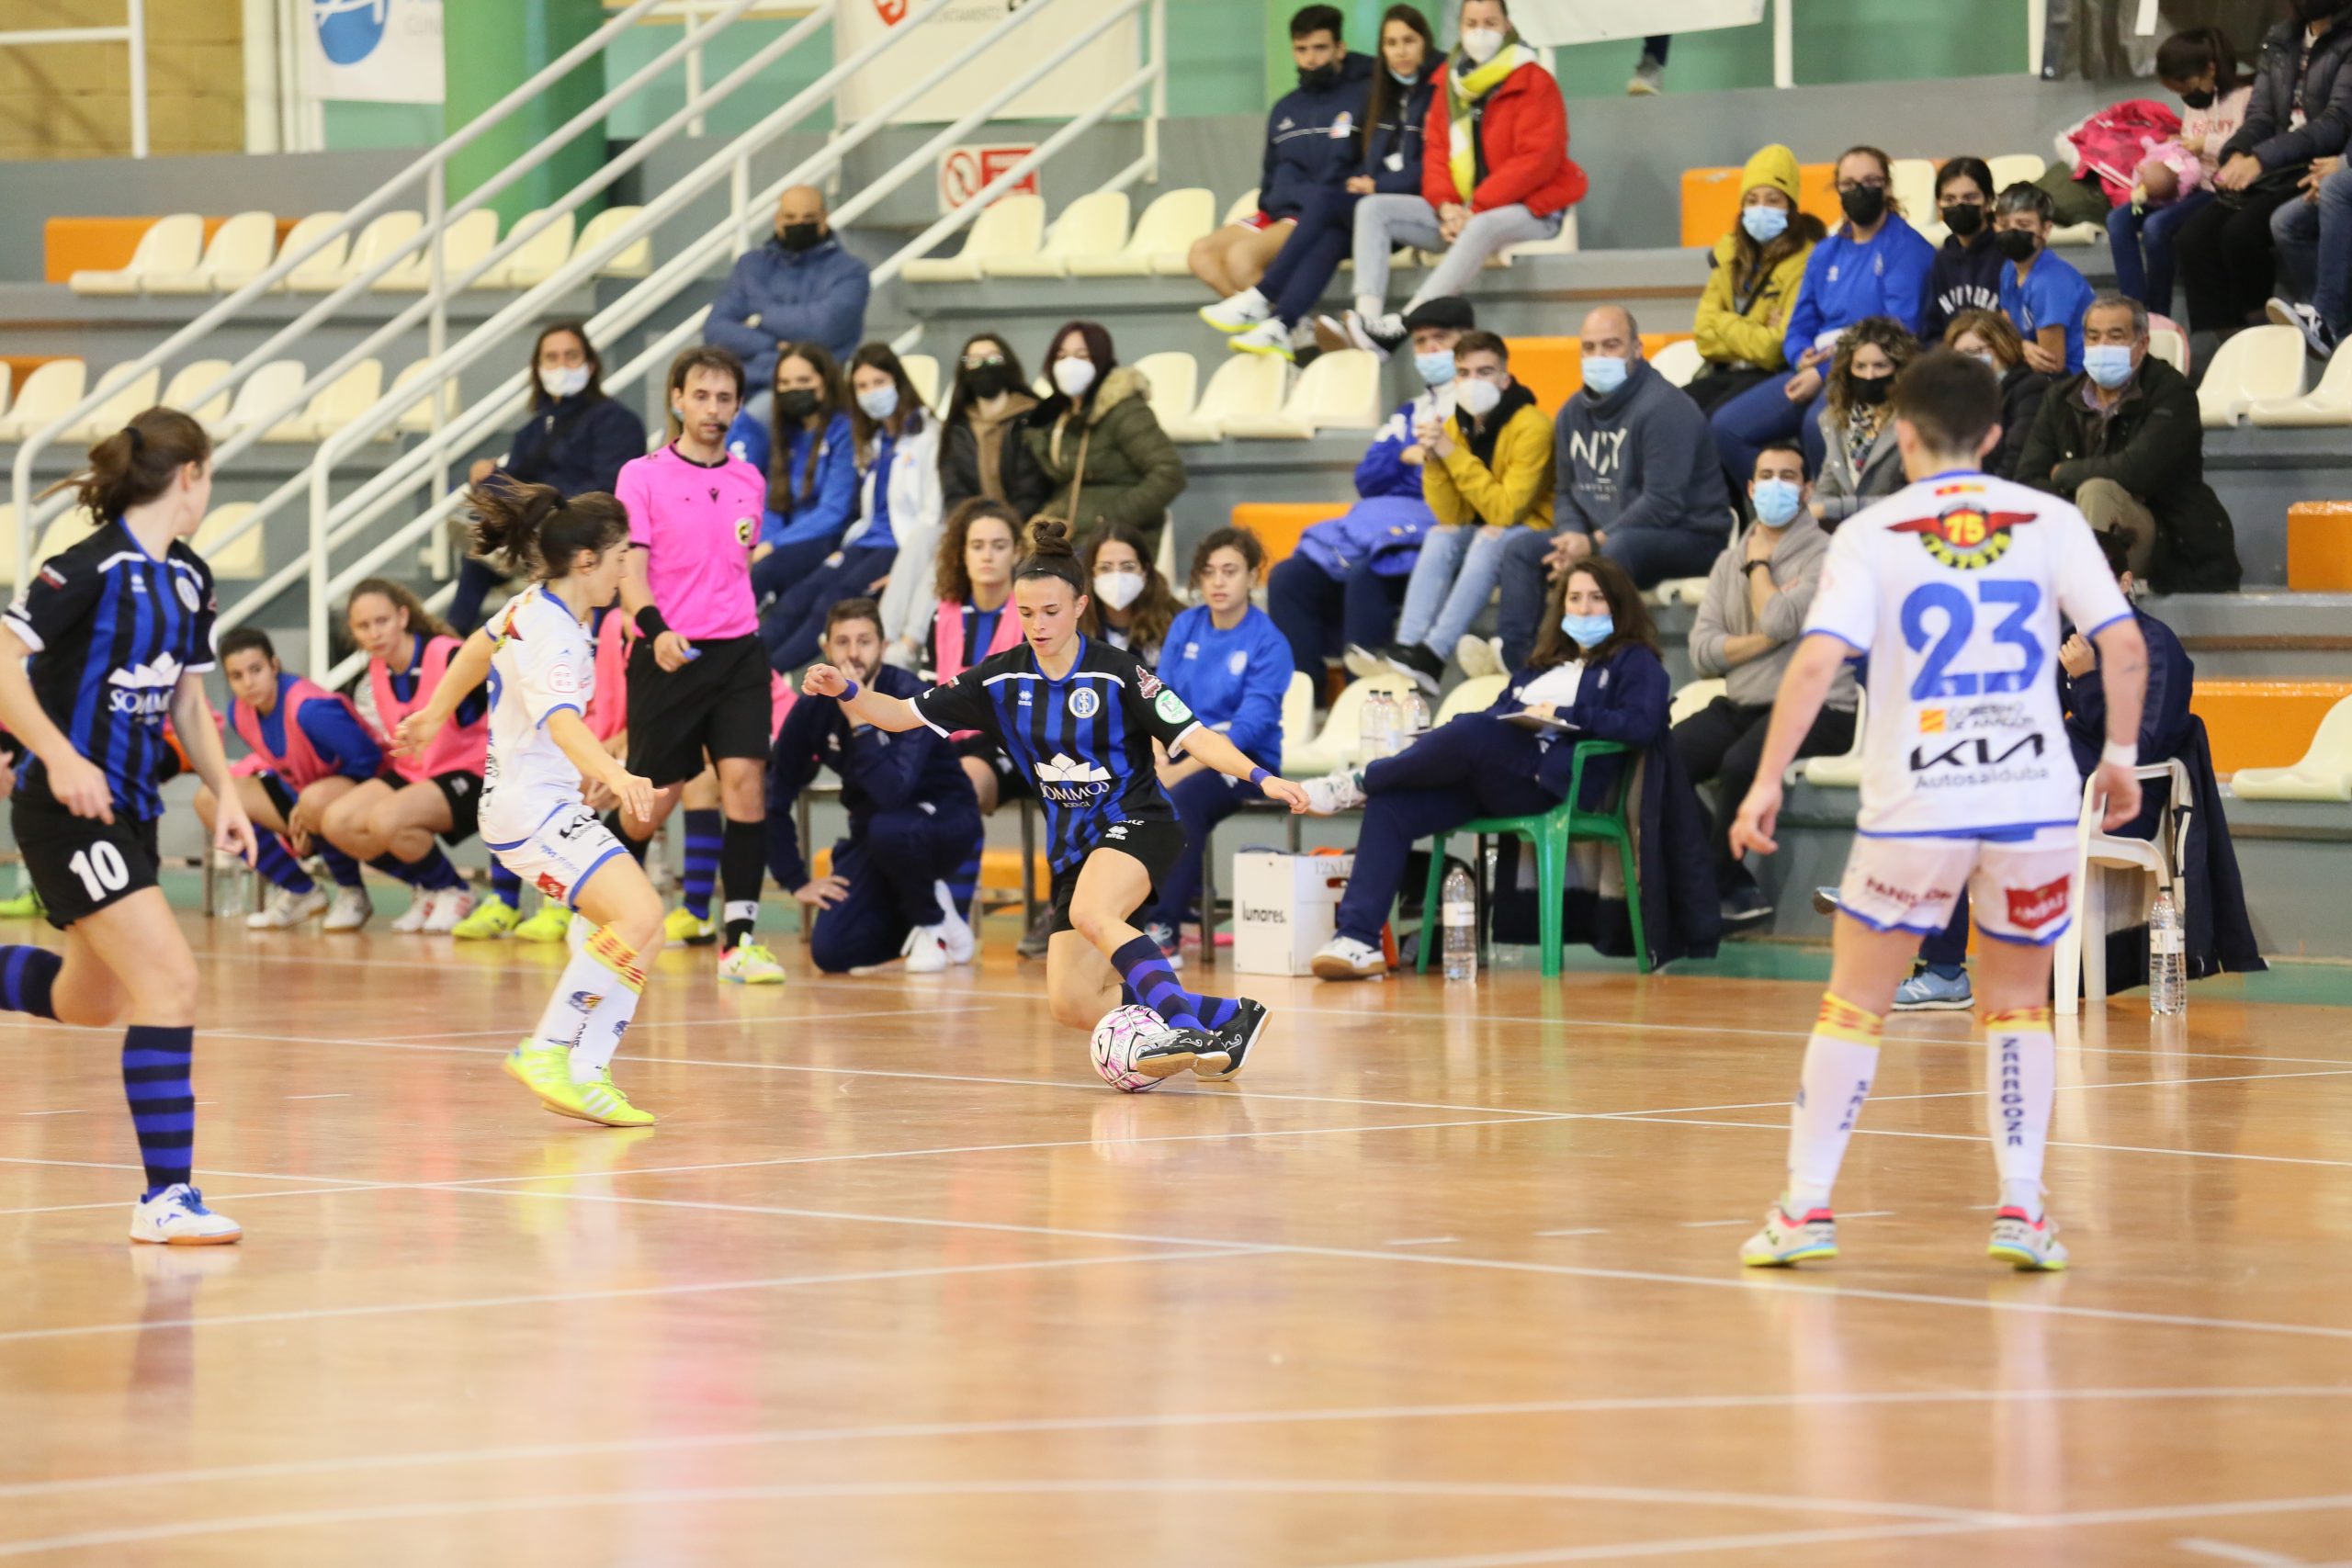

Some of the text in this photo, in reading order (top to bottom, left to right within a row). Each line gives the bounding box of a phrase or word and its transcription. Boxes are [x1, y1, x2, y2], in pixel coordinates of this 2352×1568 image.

[1943, 514, 1985, 545] 75
[1901, 580, 2044, 701] 23
[1910, 733, 2044, 772] KIA
[69, 840, 130, 902] 10
